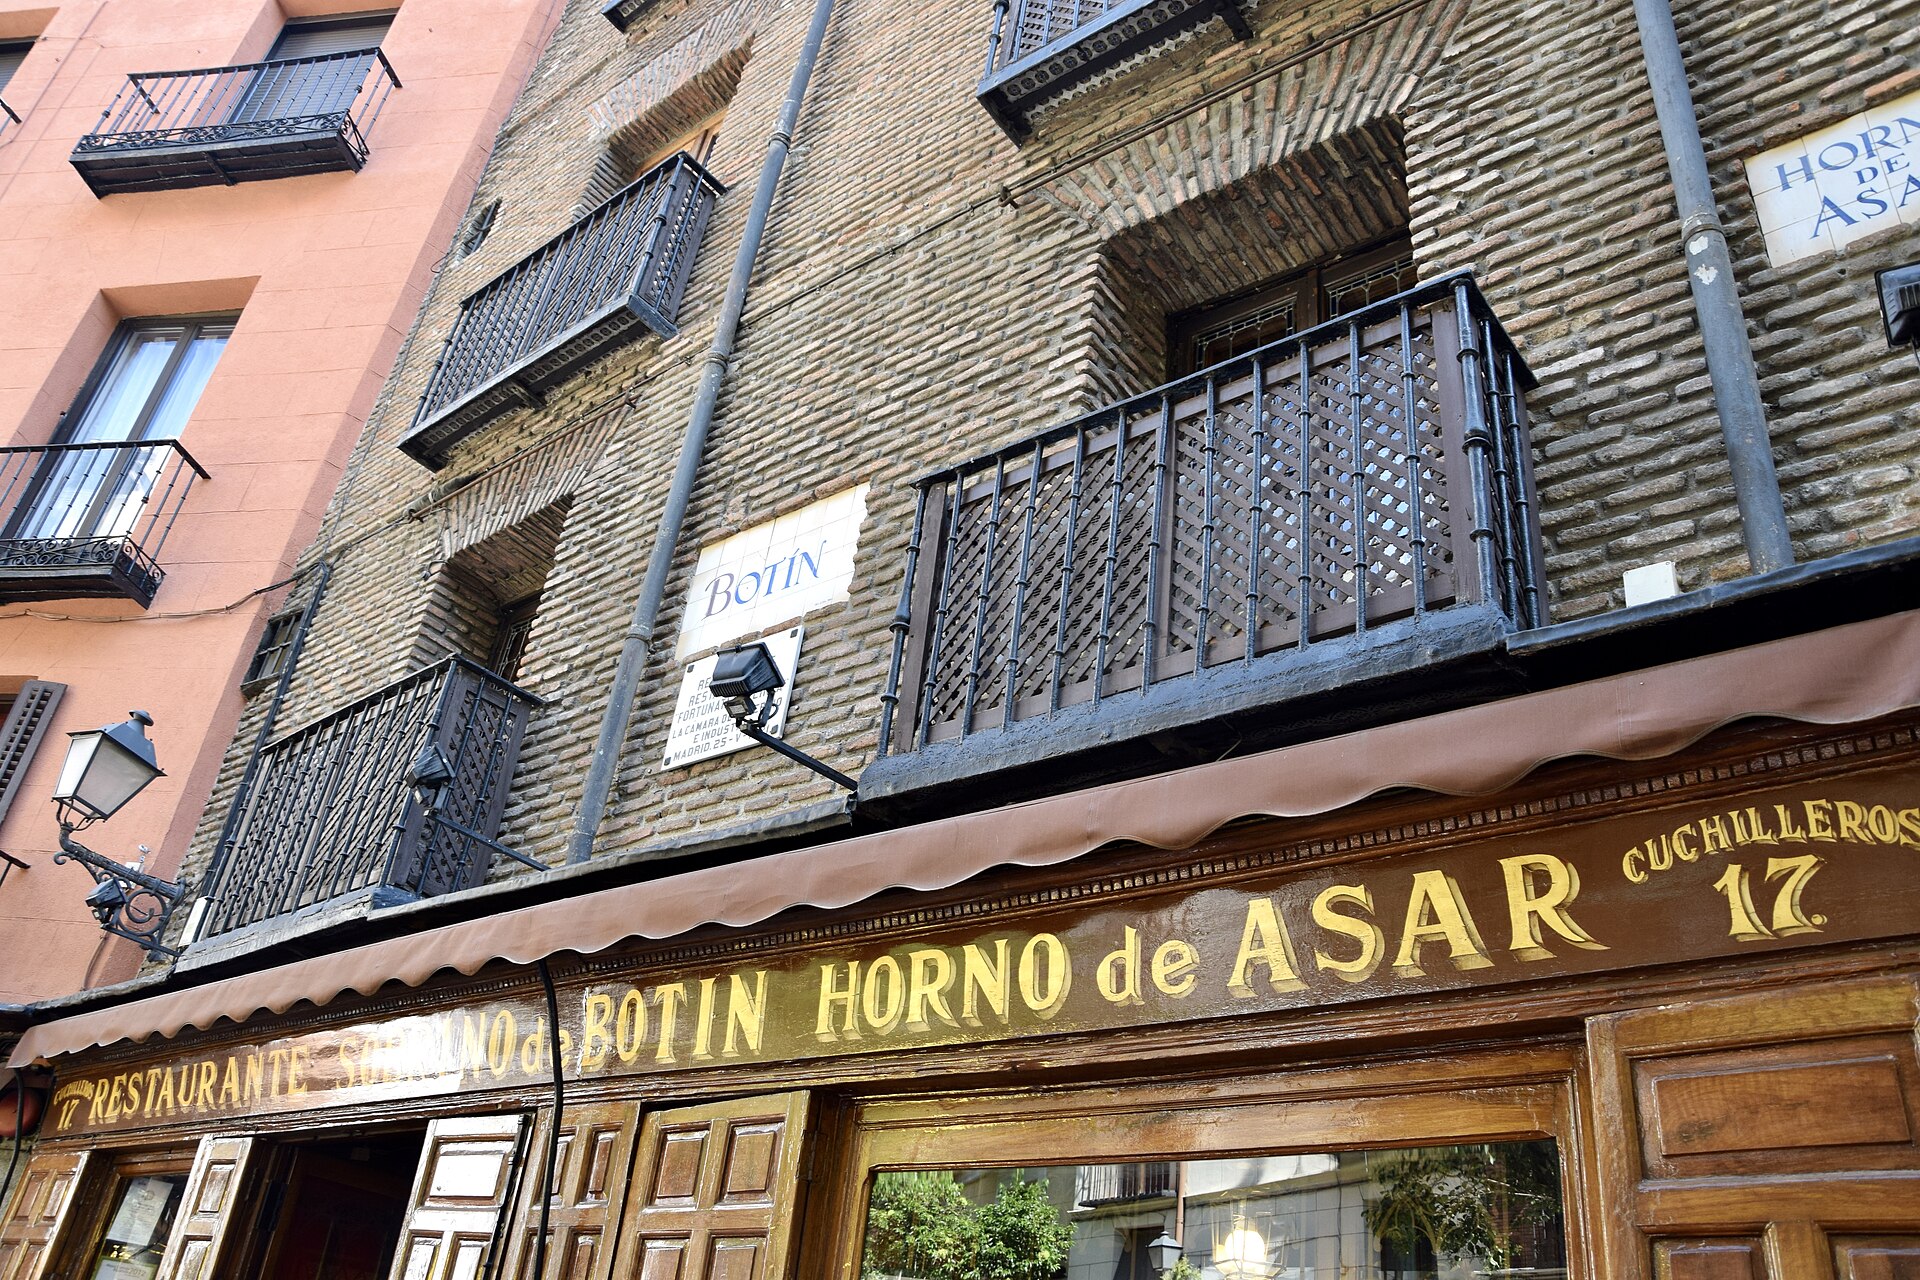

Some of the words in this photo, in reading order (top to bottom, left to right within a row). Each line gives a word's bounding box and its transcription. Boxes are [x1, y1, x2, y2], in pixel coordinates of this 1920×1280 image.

[1853, 152, 1910, 186] DE
[700, 539, 827, 621] BOTÍN
[701, 722, 738, 742] INDUST
[1620, 797, 1920, 885] CUCHILLEROS
[88, 1045, 309, 1125] RESTAURANTE
[521, 1016, 574, 1075] de
[580, 969, 768, 1073] BOTIN
[816, 932, 1072, 1042] HORNO
[1096, 924, 1200, 1006] de
[1226, 854, 1611, 999] ASAR
